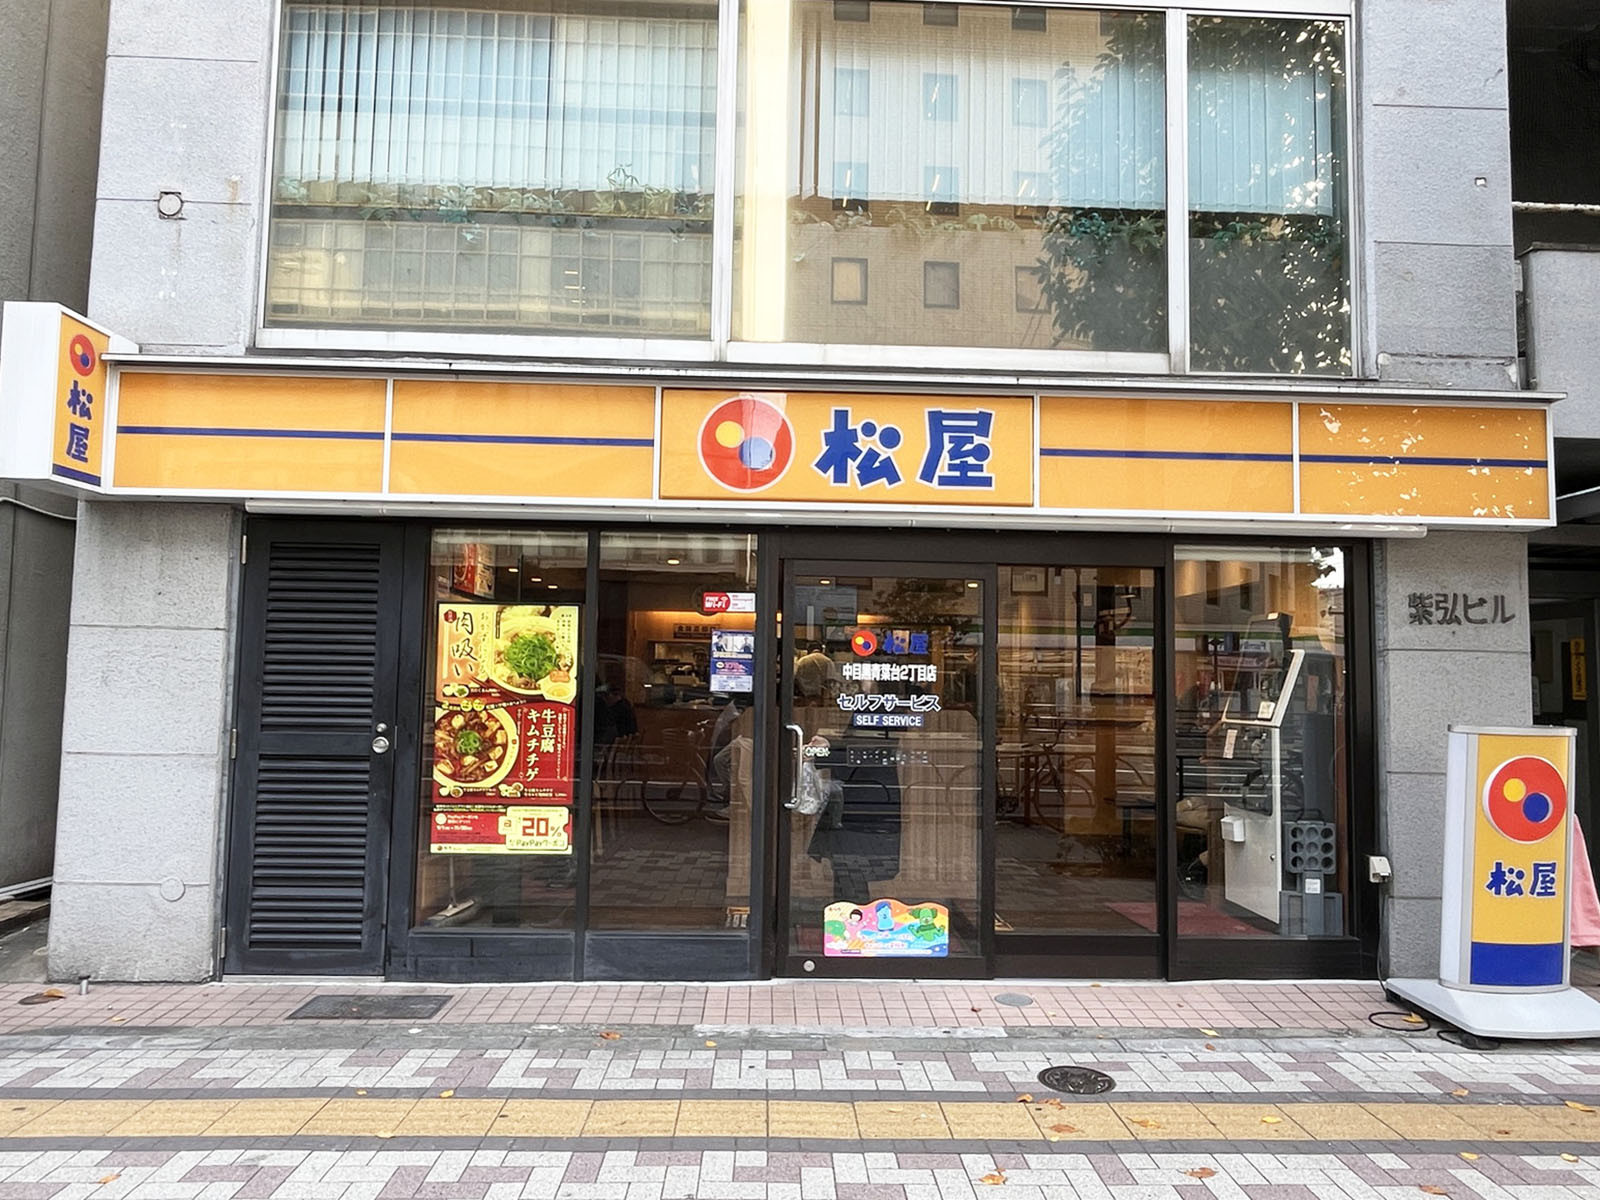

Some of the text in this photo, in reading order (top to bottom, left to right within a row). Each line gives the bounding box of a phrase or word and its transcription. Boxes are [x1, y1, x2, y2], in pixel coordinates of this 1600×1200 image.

[67, 380, 93, 463] 松屋
[813, 408, 994, 489] 松屋
[451, 611, 478, 677] 肉吸い
[882, 631, 929, 654] 松屋
[842, 663, 937, 682] 中目黒青葉台2丁目店
[837, 693, 941, 711] セルフサービス
[540, 708, 557, 753] 牛豆腐
[856, 715, 922, 726] SELF SERVICE
[526, 708, 541, 782] キムチチゲ
[805, 746, 830, 757] OPEN
[1486, 861, 1557, 897] 松屋
